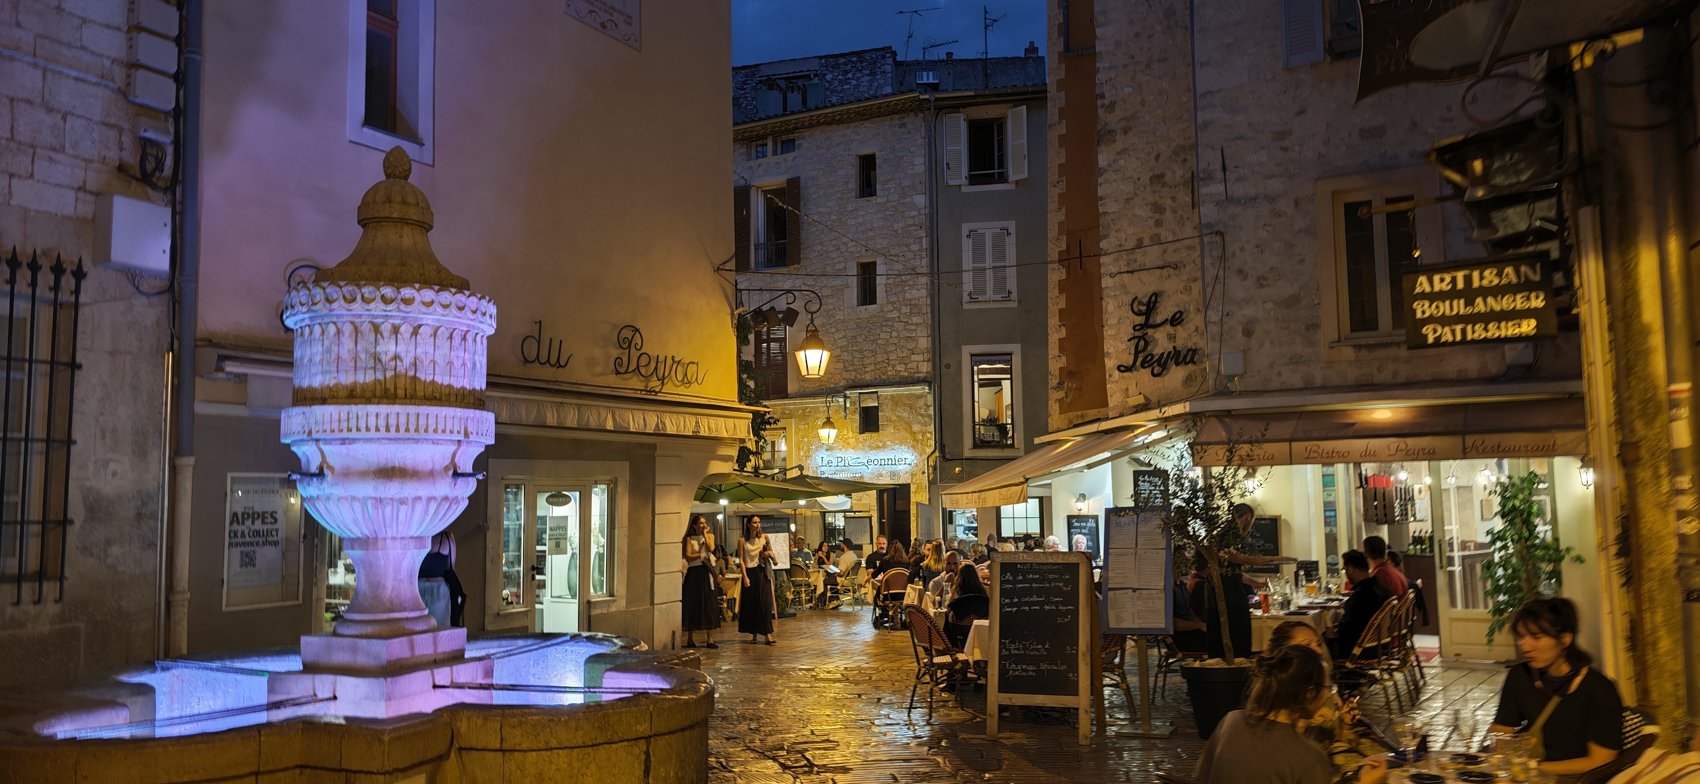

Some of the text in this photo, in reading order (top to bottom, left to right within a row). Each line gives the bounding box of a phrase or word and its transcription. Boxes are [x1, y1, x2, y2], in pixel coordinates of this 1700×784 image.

[1413, 262, 1541, 294] ARTISAN
[1131, 292, 1184, 331] Le
[1412, 290, 1546, 319] BOULANGER
[1421, 318, 1537, 345] PATISSIER
[520, 320, 709, 396] du Peyra
[1117, 332, 1198, 378] Peyra
[1304, 440, 1437, 460] Bistro du Peyra
[1462, 438, 1558, 456] Restaurant
[819, 456, 833, 467] Le
[247, 528, 280, 539] COLLECT
